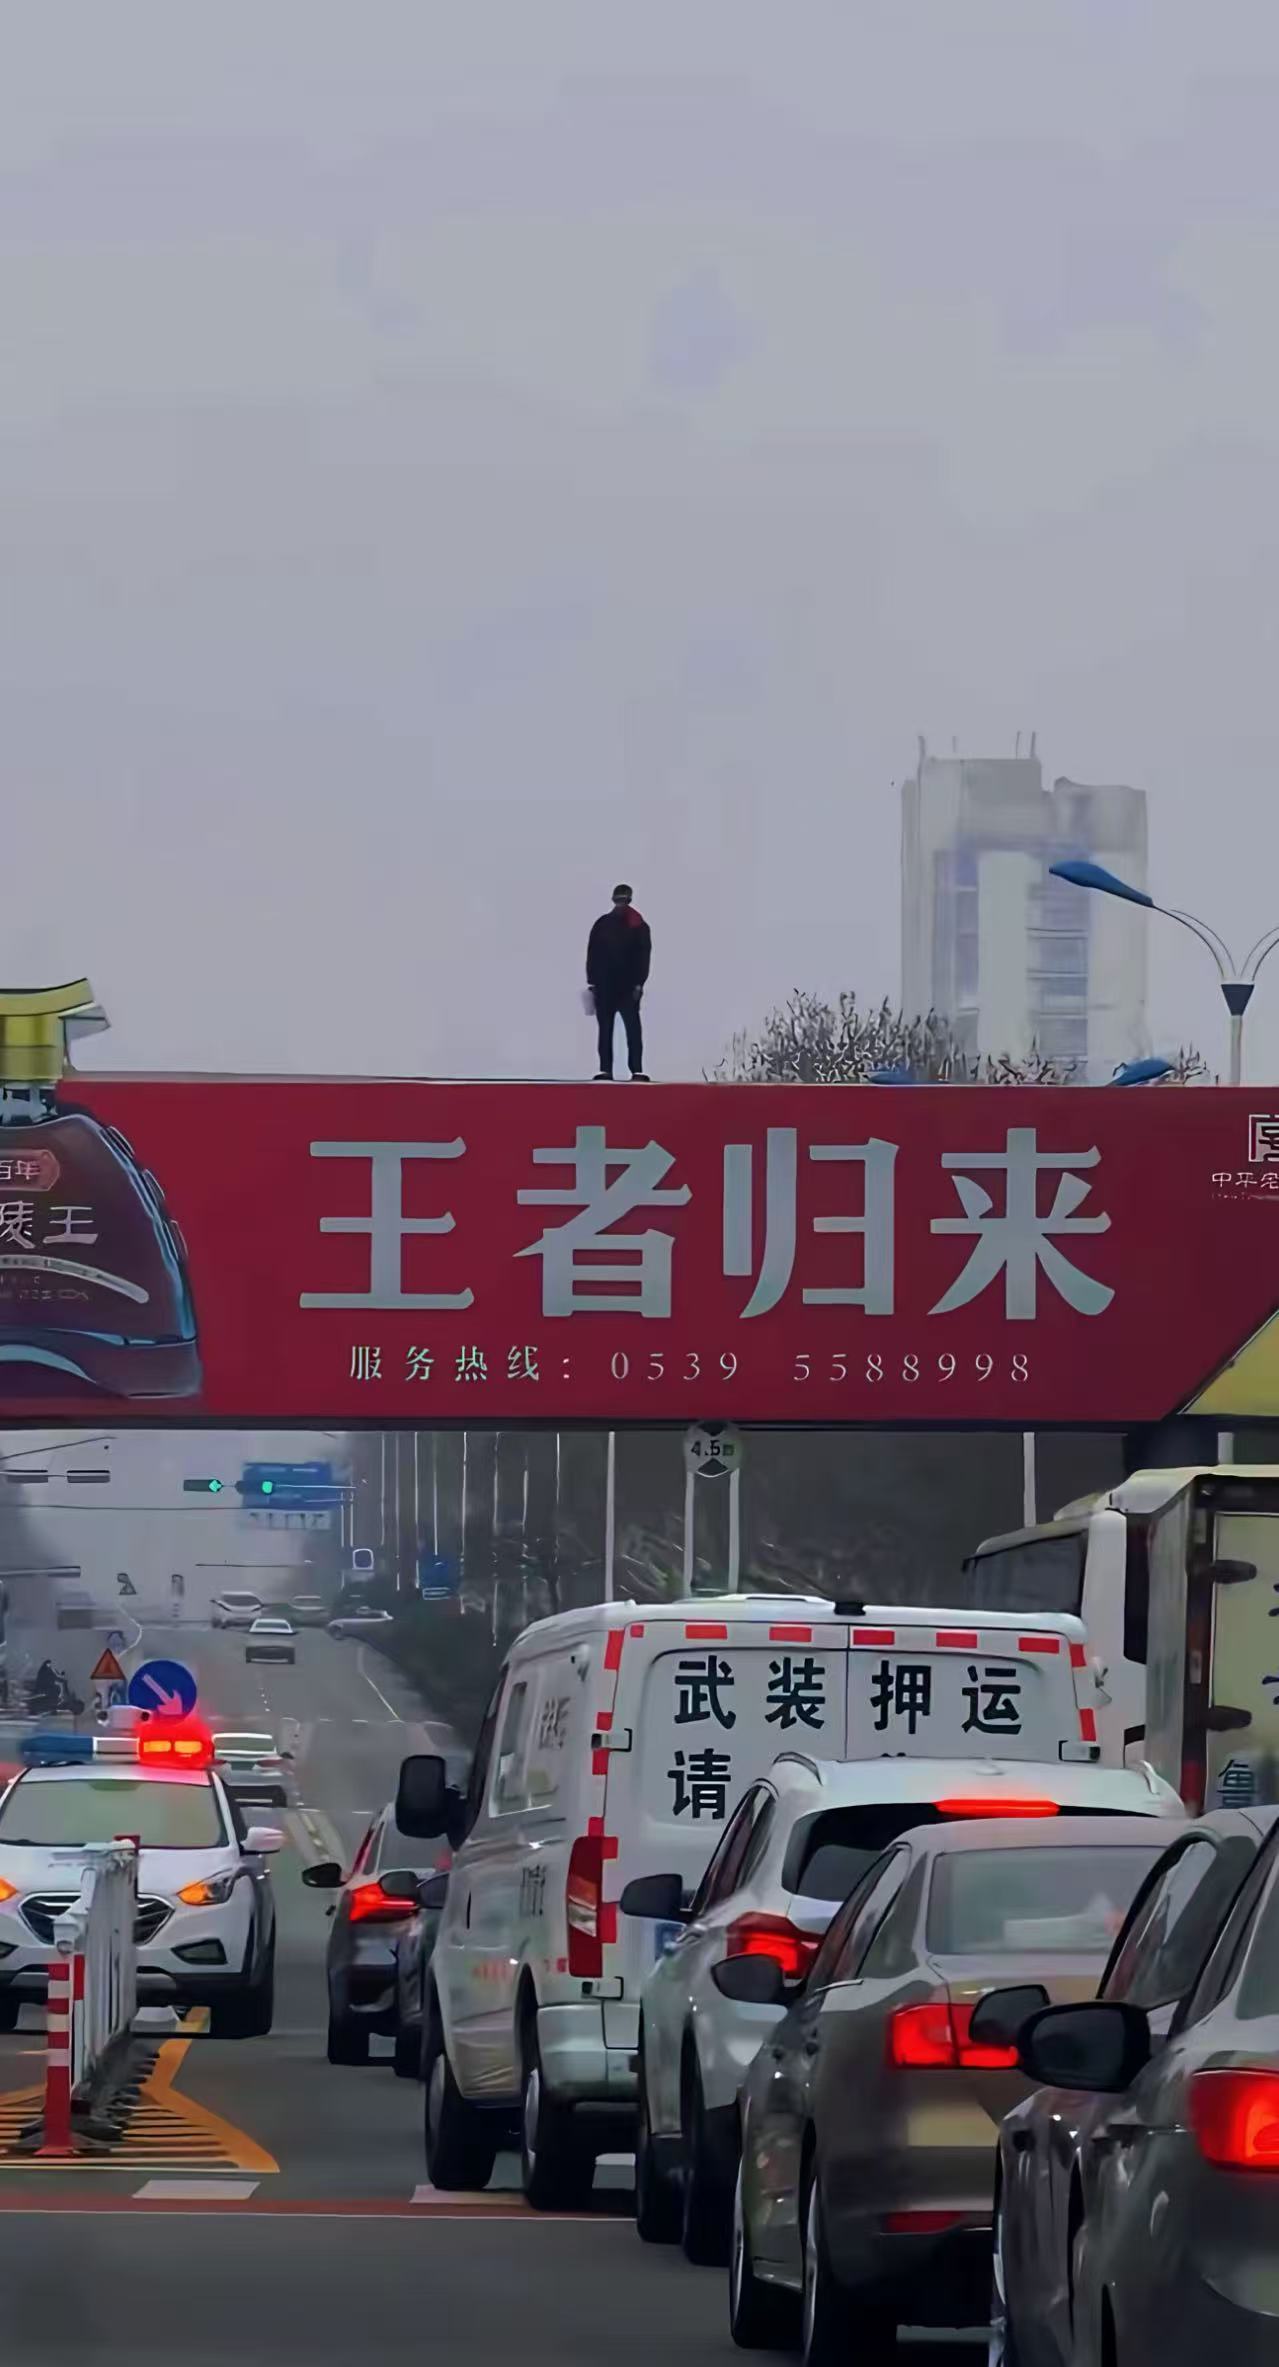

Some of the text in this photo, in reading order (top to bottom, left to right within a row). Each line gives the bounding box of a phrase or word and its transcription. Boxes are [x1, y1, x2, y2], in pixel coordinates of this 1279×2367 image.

[299, 1125, 1115, 1321] 王者归来
[610, 1351, 739, 1381] 0539
[792, 1351, 1030, 1382] 5588998
[673, 1655, 1022, 1735] 武装押运
[667, 1748, 732, 1820] 请
